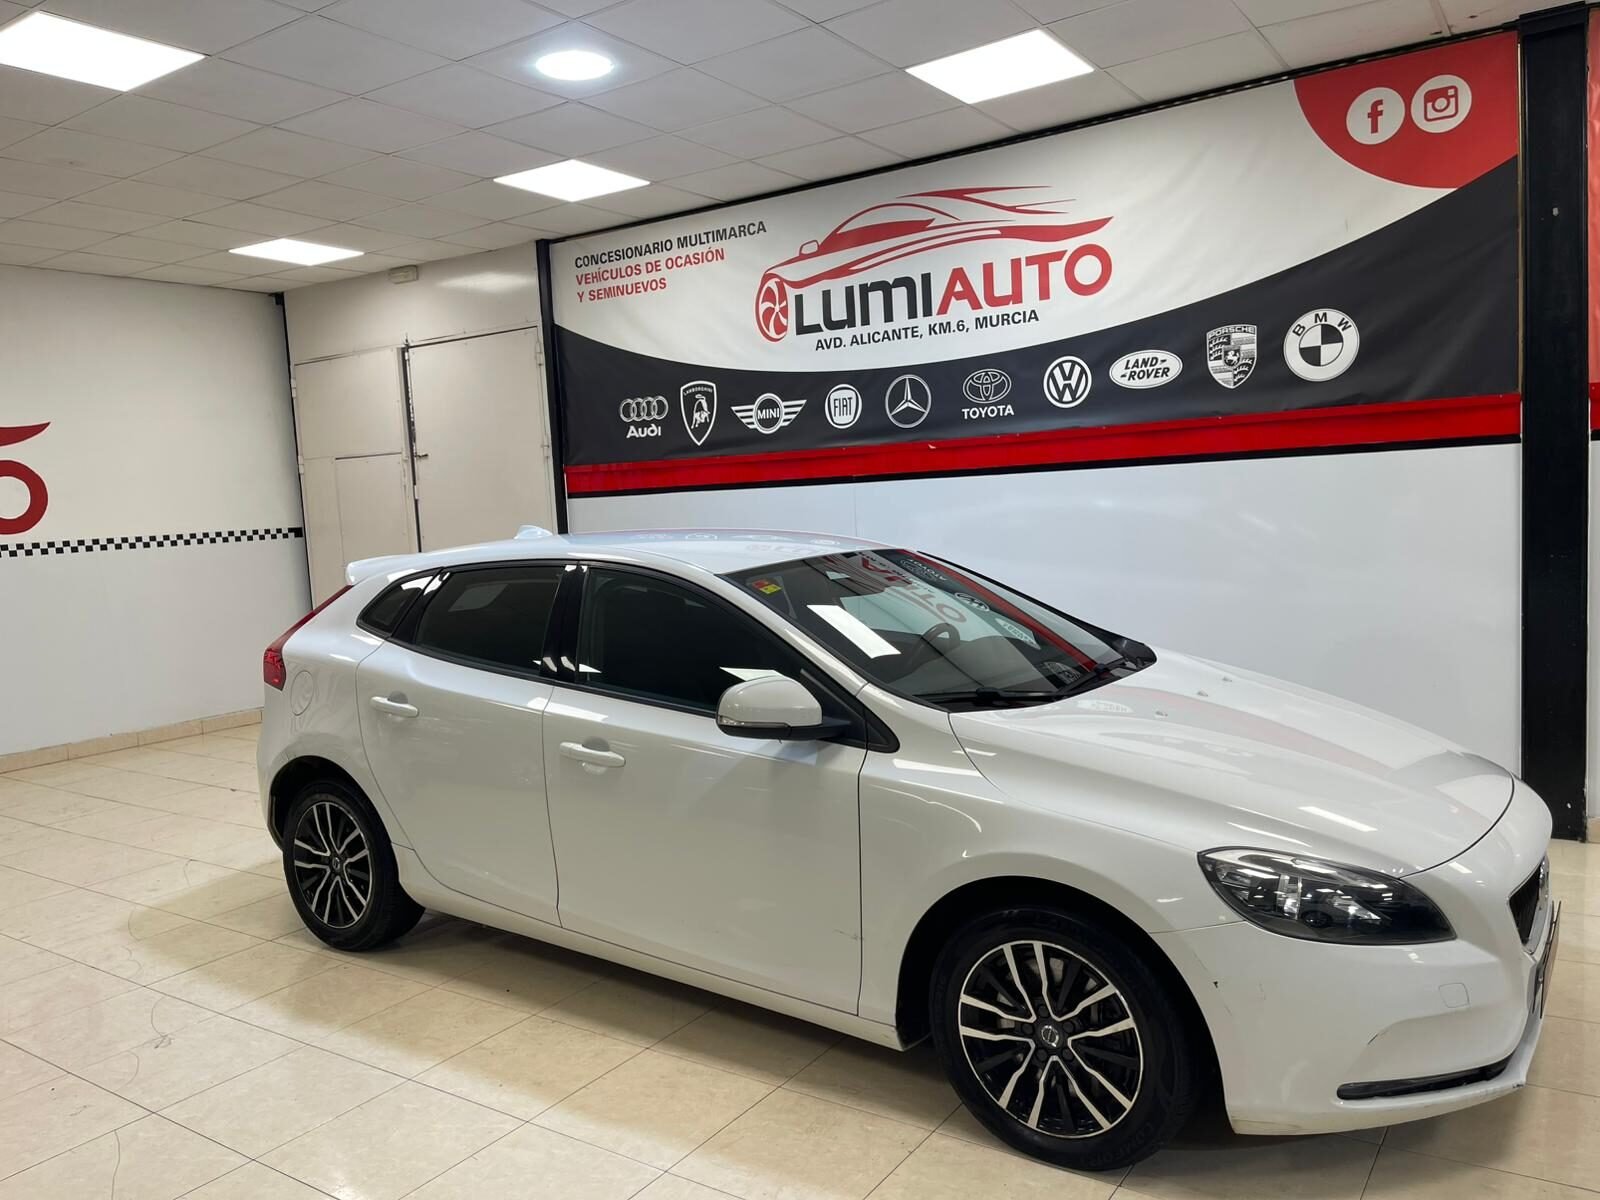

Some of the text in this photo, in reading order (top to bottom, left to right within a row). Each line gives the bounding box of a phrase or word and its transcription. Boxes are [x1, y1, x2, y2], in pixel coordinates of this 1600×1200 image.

[575, 220, 767, 269] CONCESIONARIO MULTIMARCA
[575, 247, 725, 286] VEHÍCULOS DE OCASIÓN
[577, 277, 667, 303] Y SEMINUEVOS
[815, 309, 1040, 351] AVD. ALICANTE, KM.6, MURCIA
[1208, 326, 1255, 338] PORSCHE
[1291, 312, 1353, 337] BMW
[757, 407, 780, 420] MINI
[833, 396, 853, 417] FIAT
[962, 405, 1015, 420] TOYOTA
[626, 424, 662, 438] Audi
